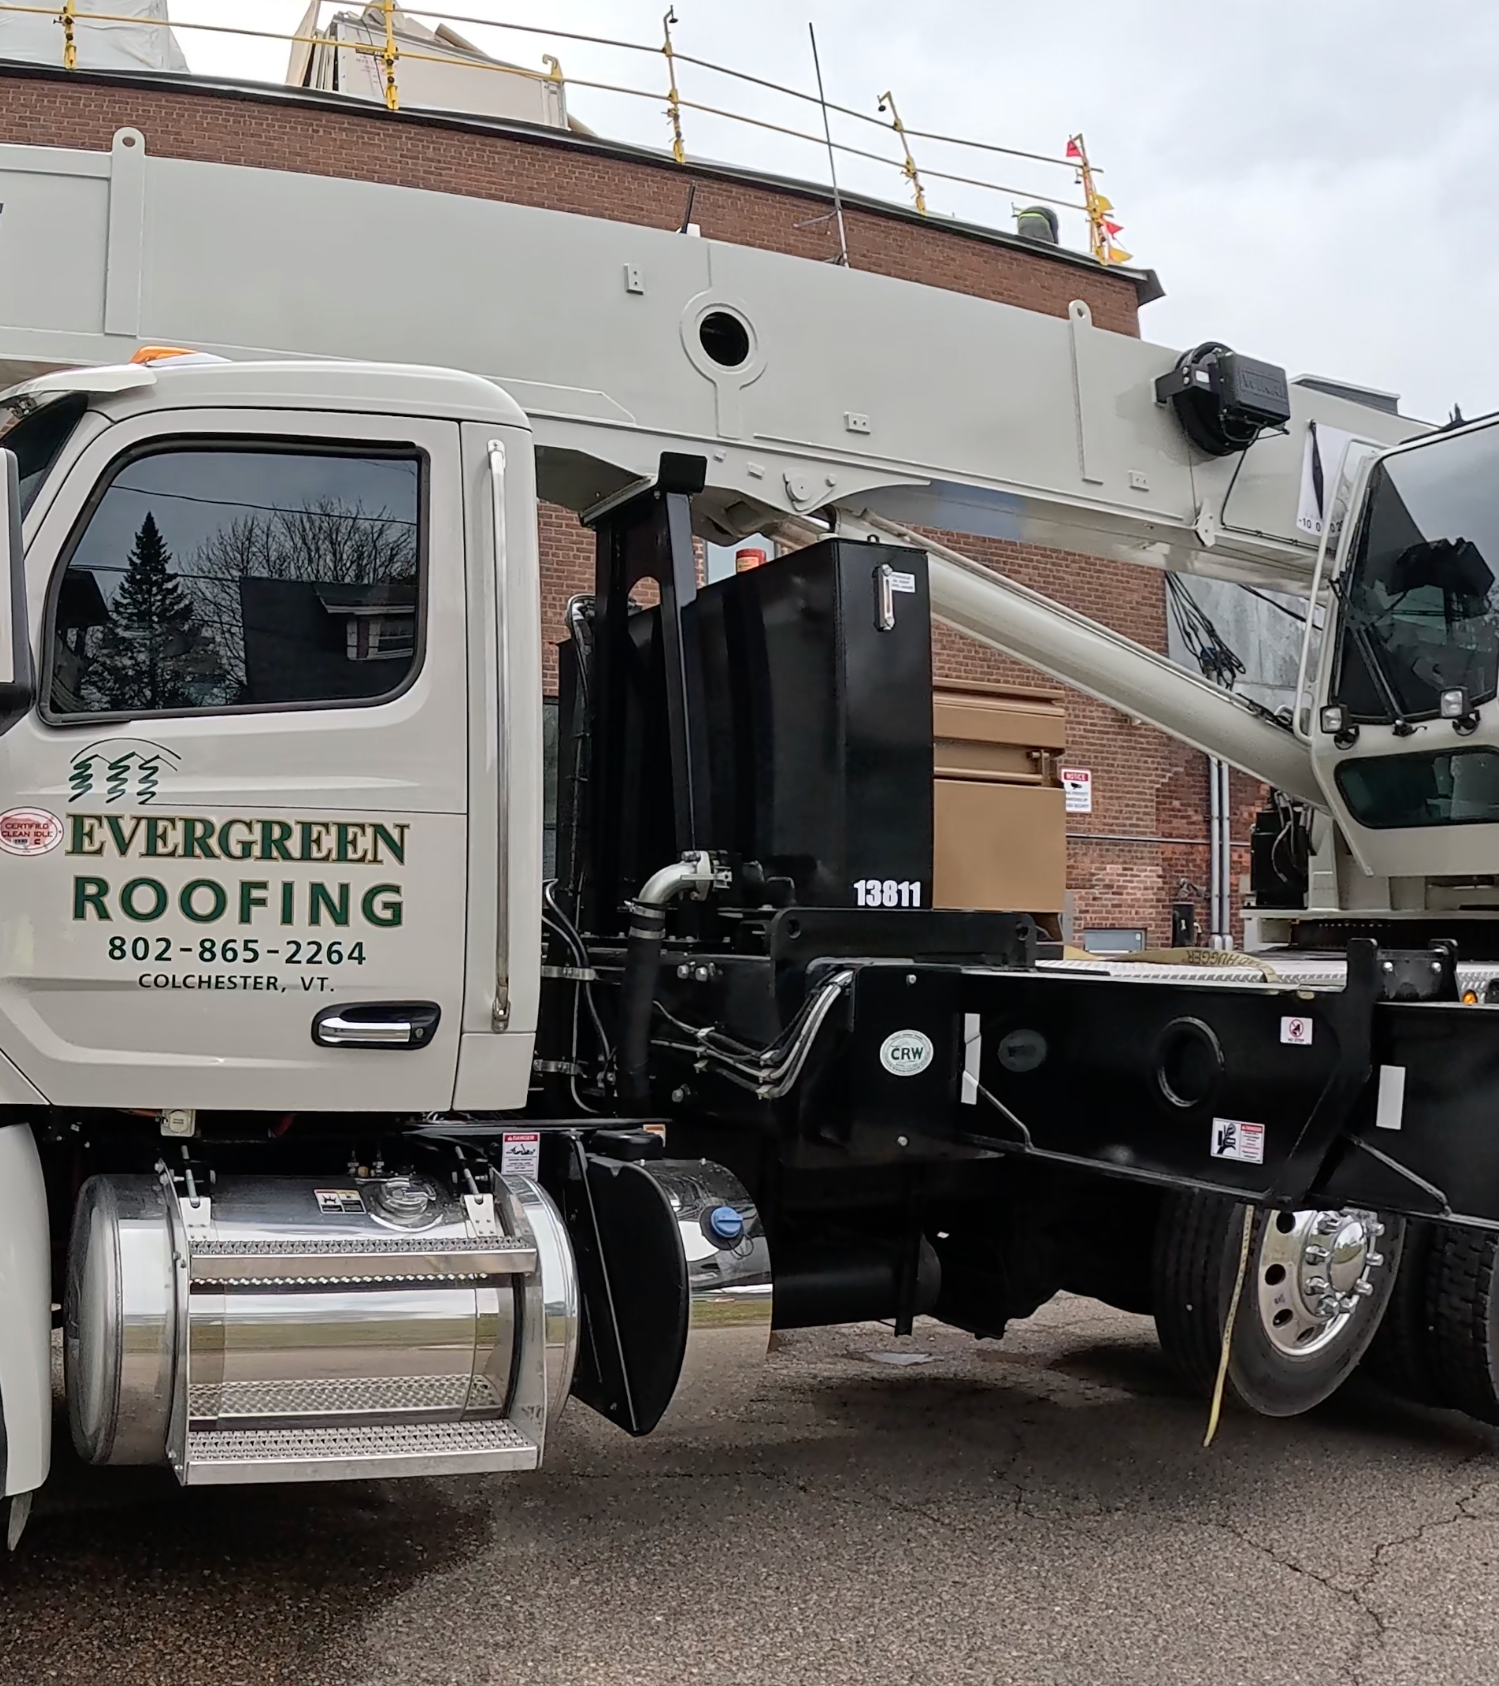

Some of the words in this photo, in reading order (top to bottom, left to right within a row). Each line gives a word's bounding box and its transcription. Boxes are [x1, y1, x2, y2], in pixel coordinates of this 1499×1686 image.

[1298, 517, 1312, 529] -10
[1315, 522, 1321, 532] 0
[1066, 772, 1086, 781] NOTICE
[1, 830, 31, 838] CLEAN
[33, 830, 53, 838] IDLE
[5, 822, 49, 830] CERTIFIED
[65, 813, 410, 866] EVERGREEN
[853, 879, 921, 907] 13811
[72, 875, 404, 929] ROOFING
[108, 935, 367, 966] 802-865-2264
[1186, 949, 1239, 965] HUGGER
[138, 973, 286, 993] COLCHESTER,
[300, 976, 335, 993] VT.
[891, 1047, 924, 1061] CRW
